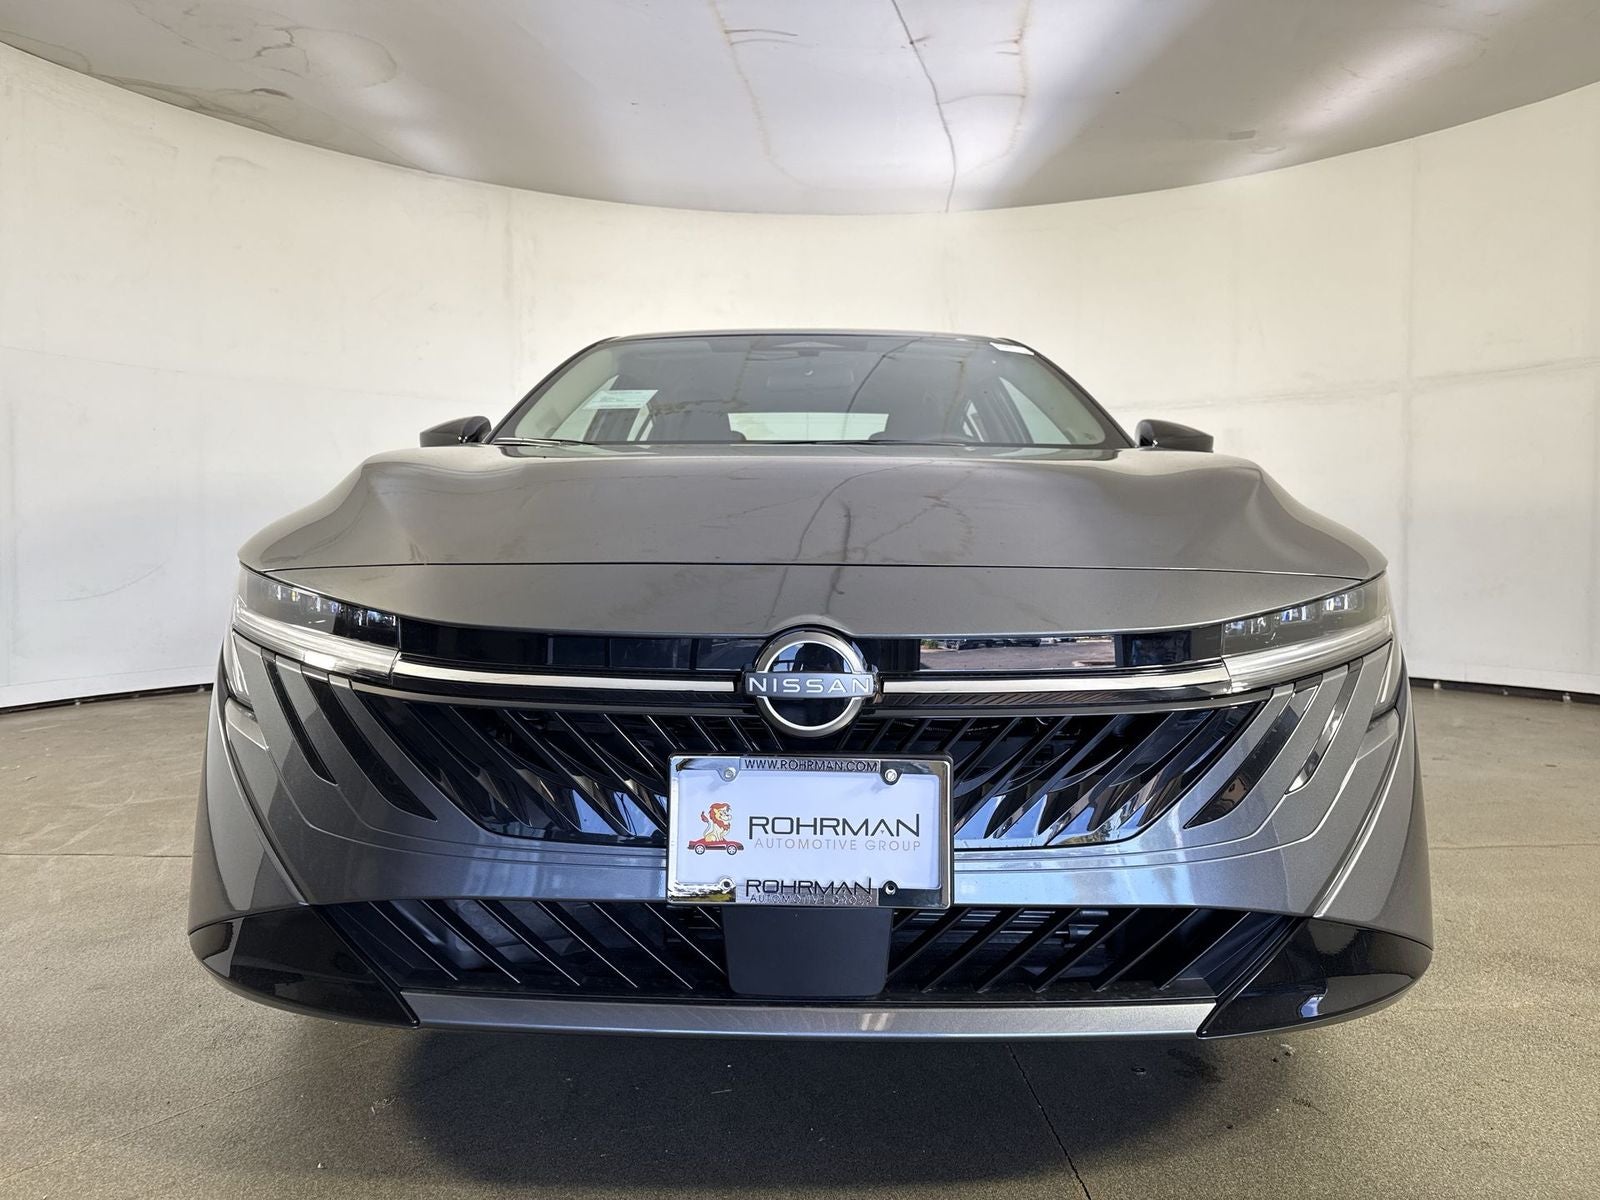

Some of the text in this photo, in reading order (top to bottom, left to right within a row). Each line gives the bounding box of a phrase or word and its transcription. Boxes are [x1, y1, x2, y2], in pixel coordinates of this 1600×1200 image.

[748, 677, 869, 693] NISSAN
[744, 759, 878, 772] WWW.ROHRMAN.COM
[748, 813, 920, 840] ROHRMAN
[754, 838, 921, 852] AUTOMOTIVE GROUP
[745, 877, 872, 897] ROHRMAN
